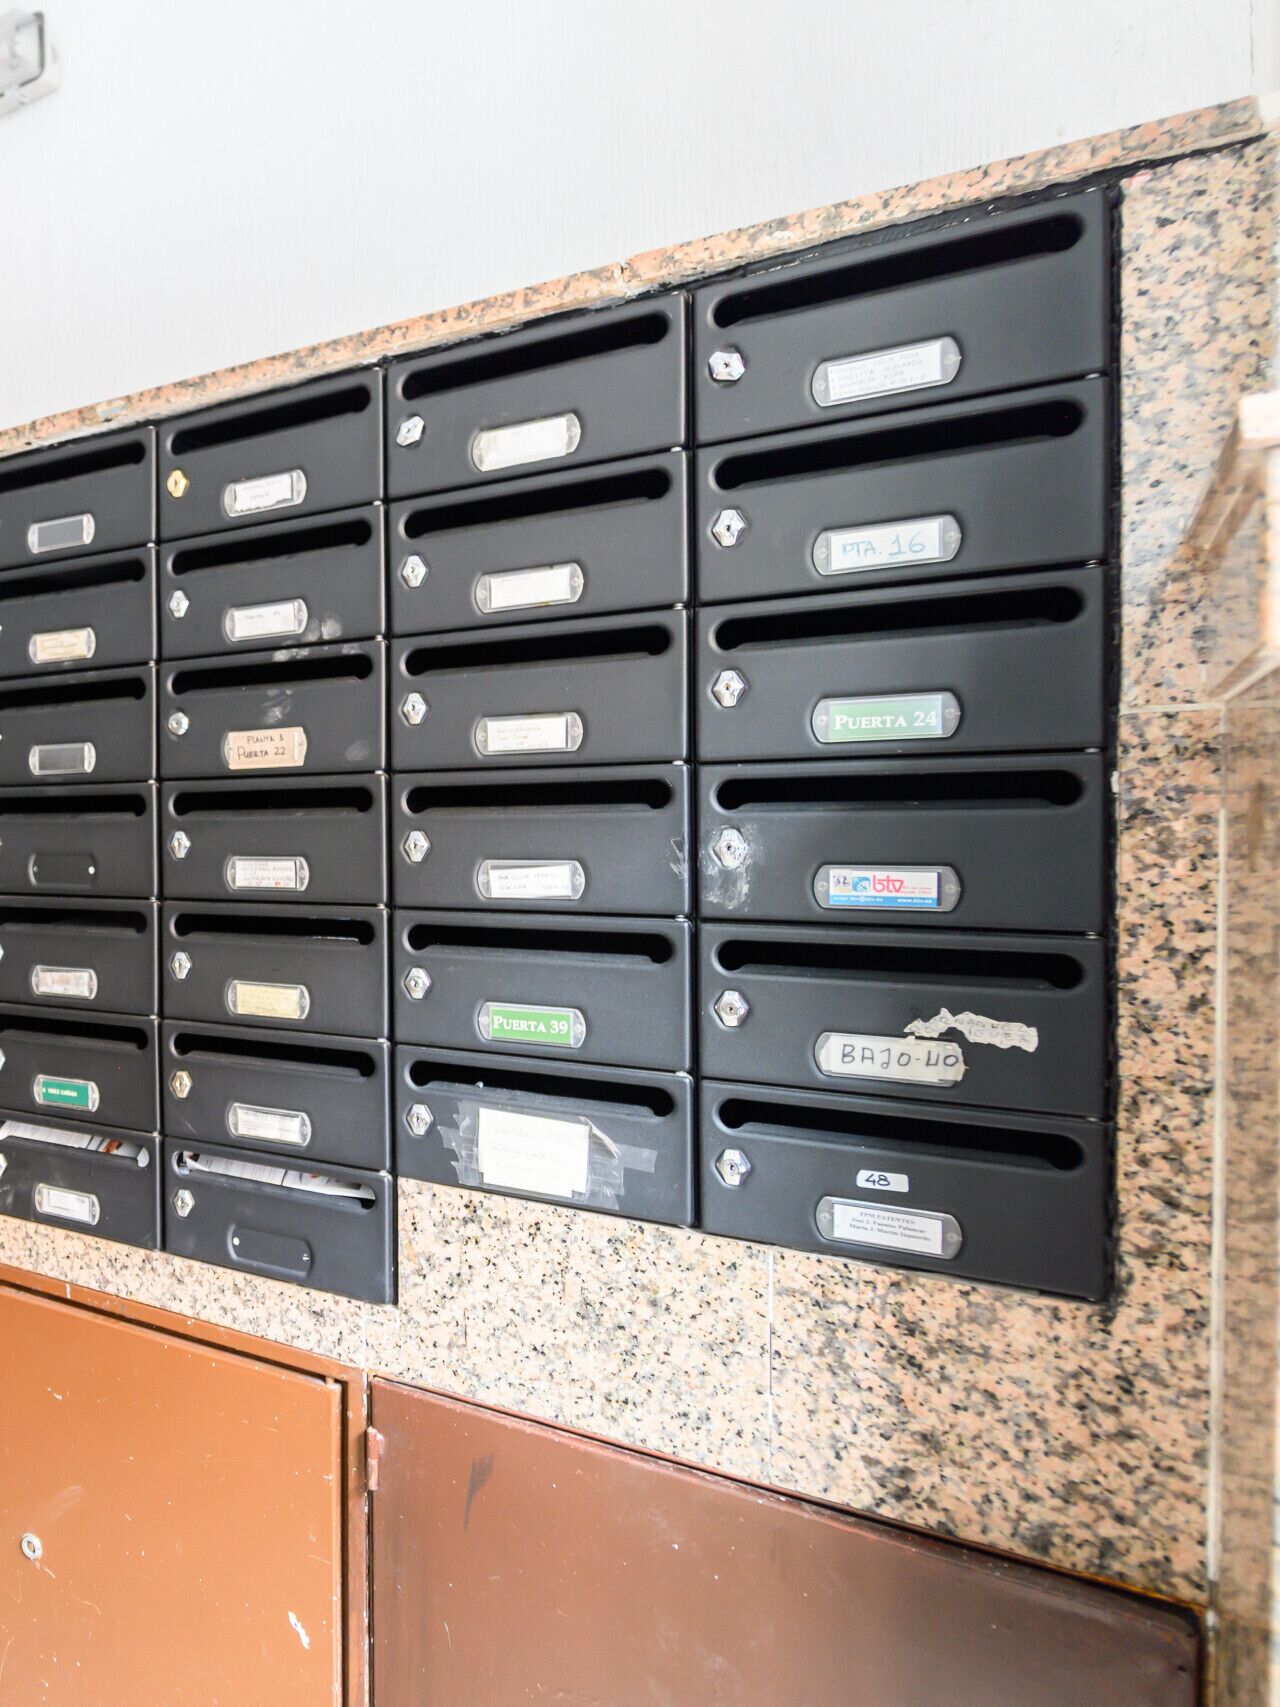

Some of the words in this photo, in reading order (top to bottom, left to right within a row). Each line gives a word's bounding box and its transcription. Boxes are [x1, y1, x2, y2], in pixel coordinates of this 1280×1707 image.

[888, 529, 926, 557] 16
[834, 714, 908, 730] PUERTA
[913, 710, 938, 727] 24
[274, 746, 287, 756] 22
[872, 874, 905, 894] btv
[493, 1015, 547, 1033] PUERTA
[550, 1020, 569, 1034] 39
[865, 1173, 891, 1187] 48
